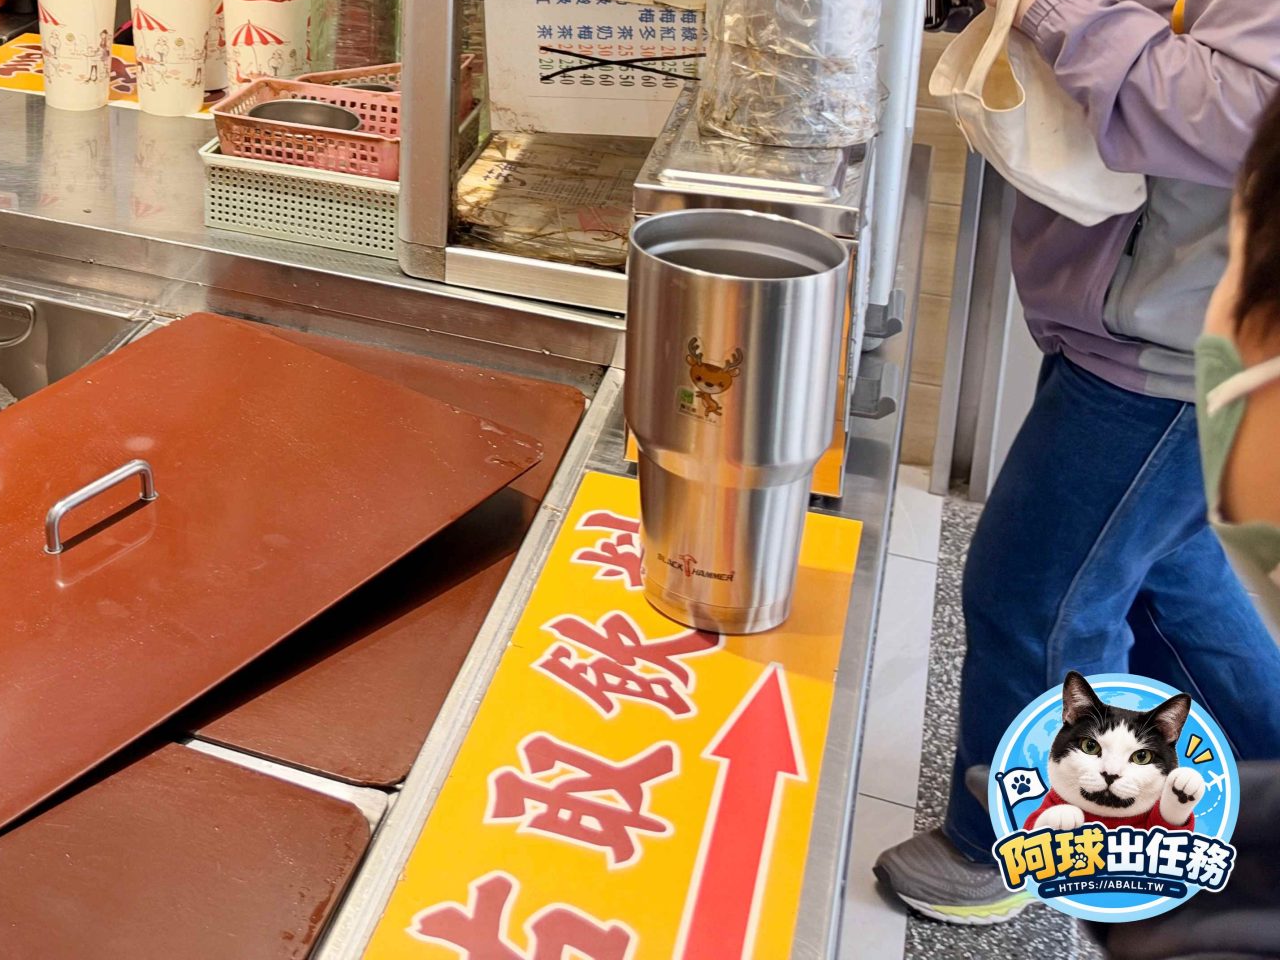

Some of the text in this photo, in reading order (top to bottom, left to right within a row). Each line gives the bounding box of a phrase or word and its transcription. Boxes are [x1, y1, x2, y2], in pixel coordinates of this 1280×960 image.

[598, 45, 613, 56] 30
[618, 45, 633, 57] 25
[539, 58, 553, 71] 20
[580, 75, 595, 86] 40
[599, 75, 614, 86] 60
[619, 75, 634, 87] 50
[641, 76, 657, 88] 60
[691, 569, 735, 582] HAMMER
